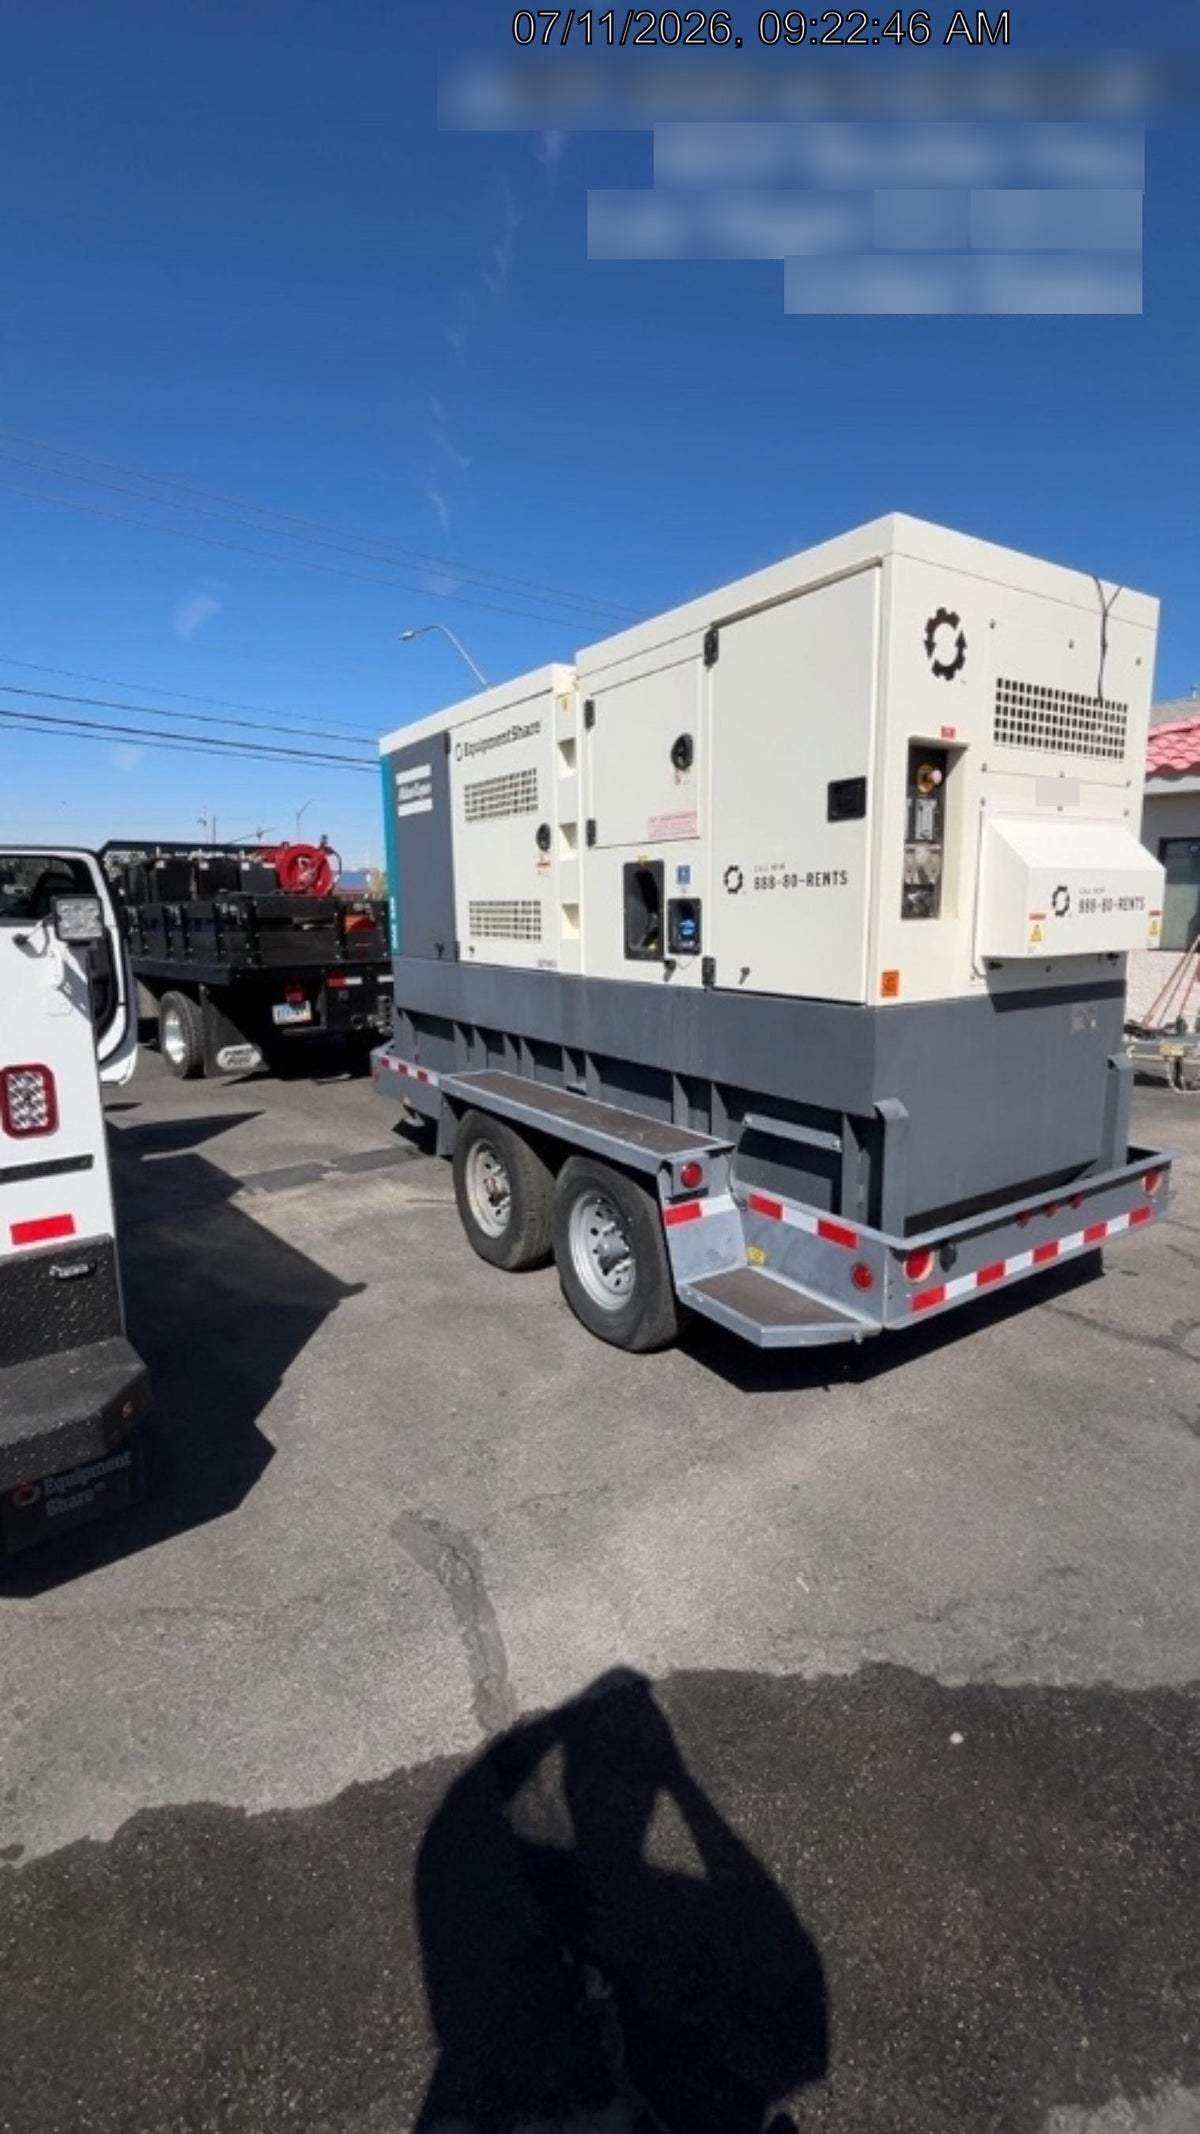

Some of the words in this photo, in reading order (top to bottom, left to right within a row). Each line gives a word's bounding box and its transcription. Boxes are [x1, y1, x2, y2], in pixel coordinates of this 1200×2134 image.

[754, 869, 848, 891] 888-80-RENTS
[1079, 896, 1145, 914] 888-80-RENTS
[45, 1451, 131, 1497] Equipment
